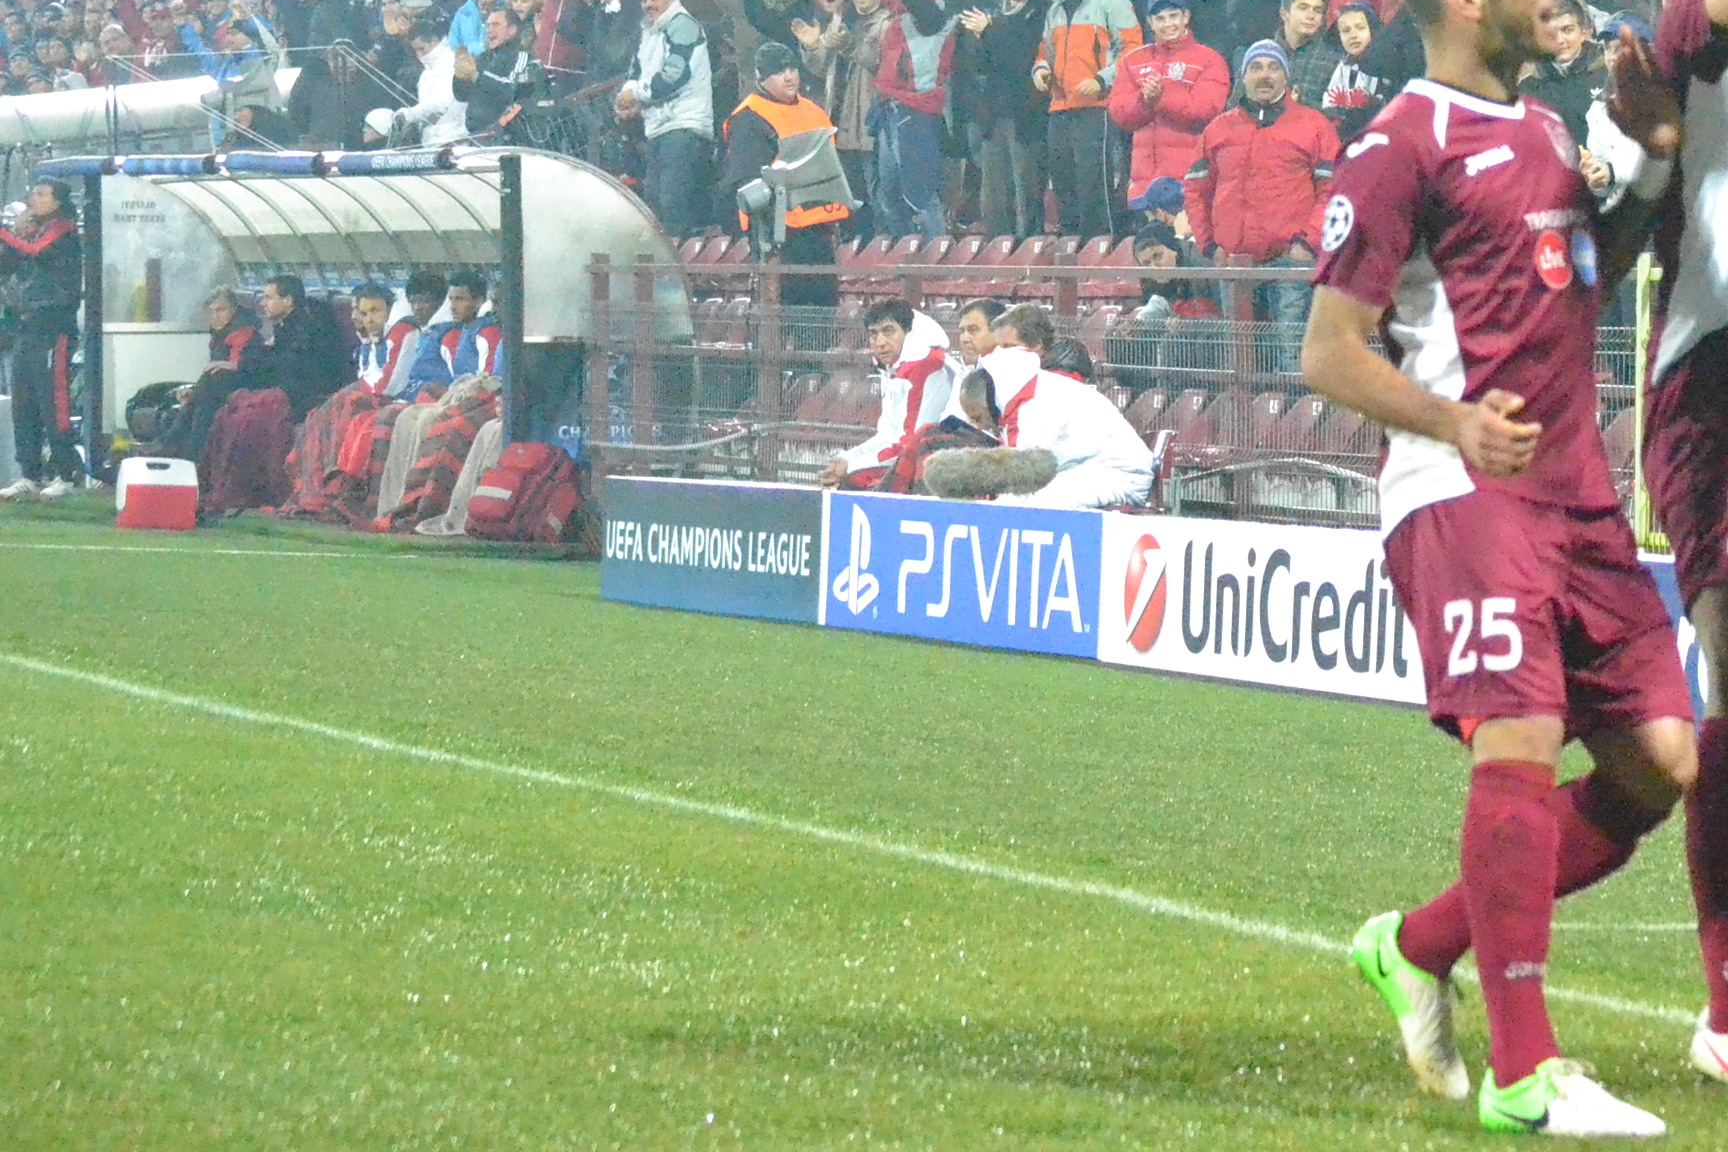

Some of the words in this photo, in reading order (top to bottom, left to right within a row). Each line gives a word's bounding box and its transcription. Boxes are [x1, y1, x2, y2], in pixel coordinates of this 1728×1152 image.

[606, 519, 643, 561] UEFA
[647, 523, 742, 571] CHAMPIONS
[748, 531, 811, 576] LEAGUE
[1181, 539, 1408, 679] UniCredit
[1443, 596, 1523, 677] 25
